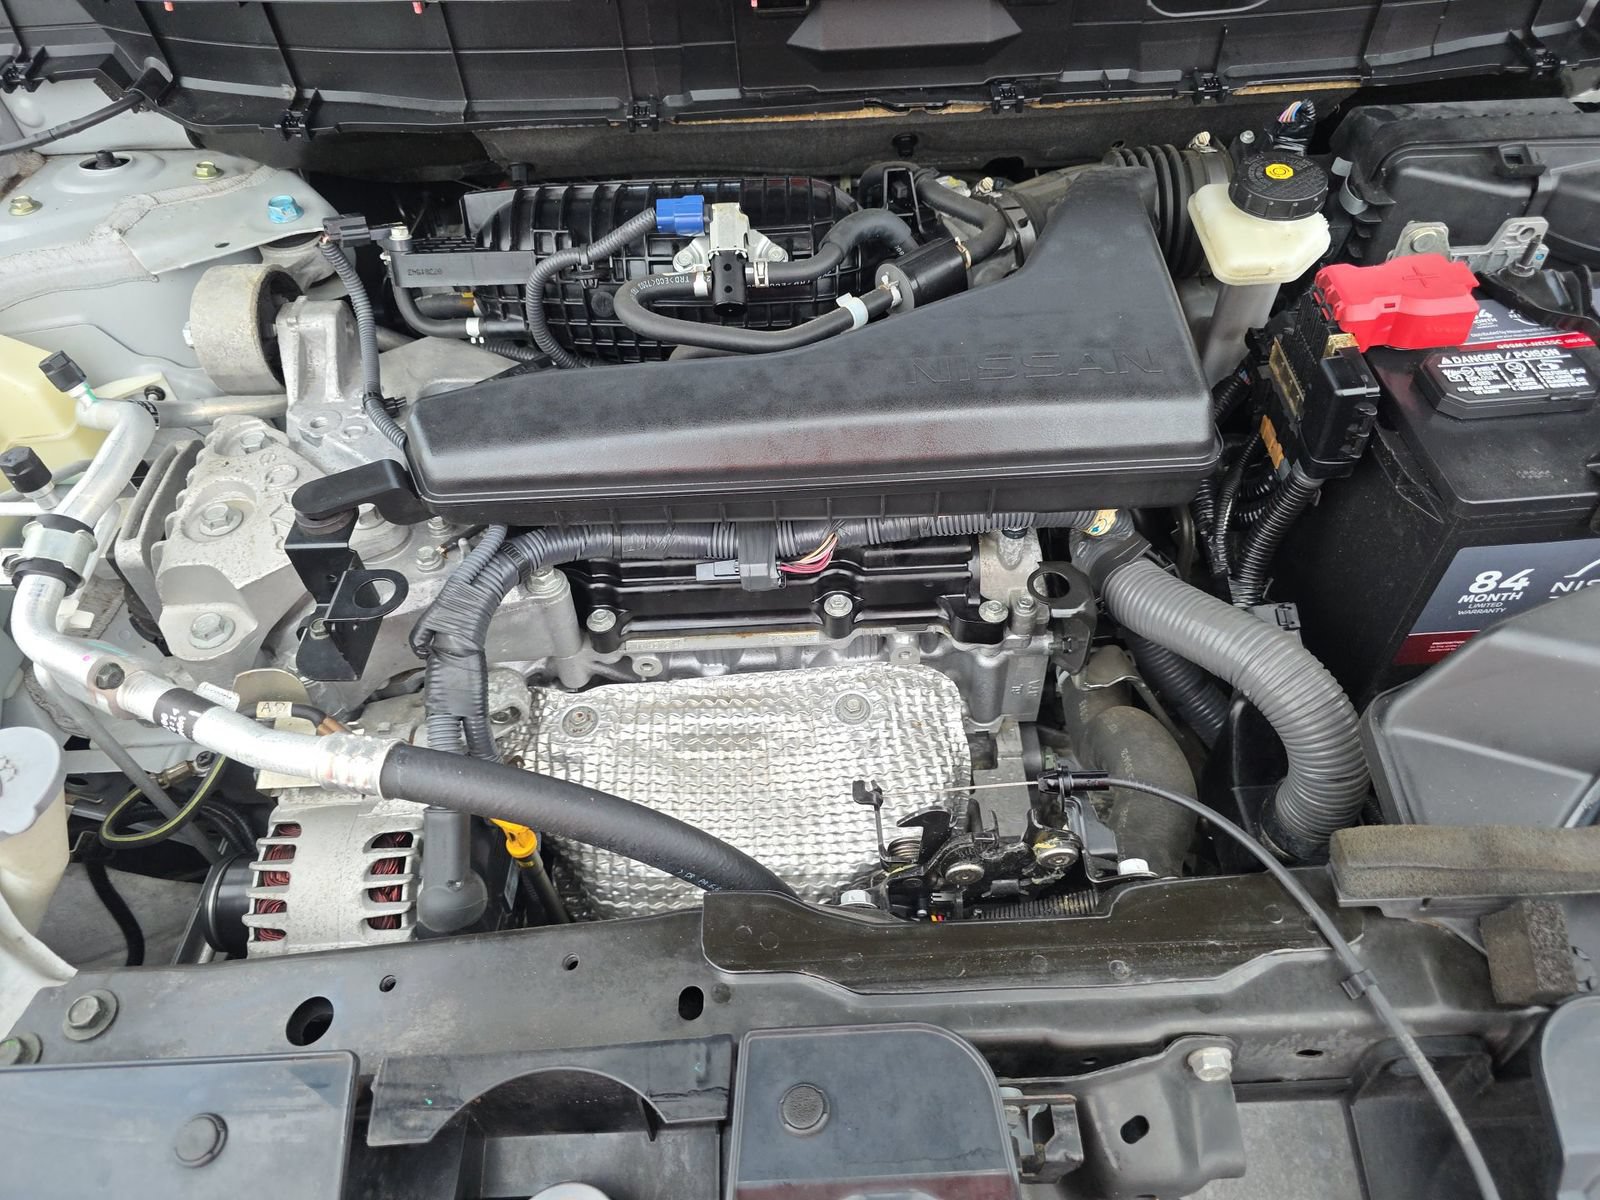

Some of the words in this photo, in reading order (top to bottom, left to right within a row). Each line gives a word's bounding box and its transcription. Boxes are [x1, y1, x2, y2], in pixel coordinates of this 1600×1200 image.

[1451, 352, 1503, 365] DANGER
[1513, 348, 1561, 360] POISON
[906, 348, 1163, 384] NISSAN
[1468, 568, 1535, 594] 84
[1457, 591, 1524, 604] MONTH
[1468, 601, 1503, 609] LIMITED
[1457, 607, 1507, 616] WARRANTY
